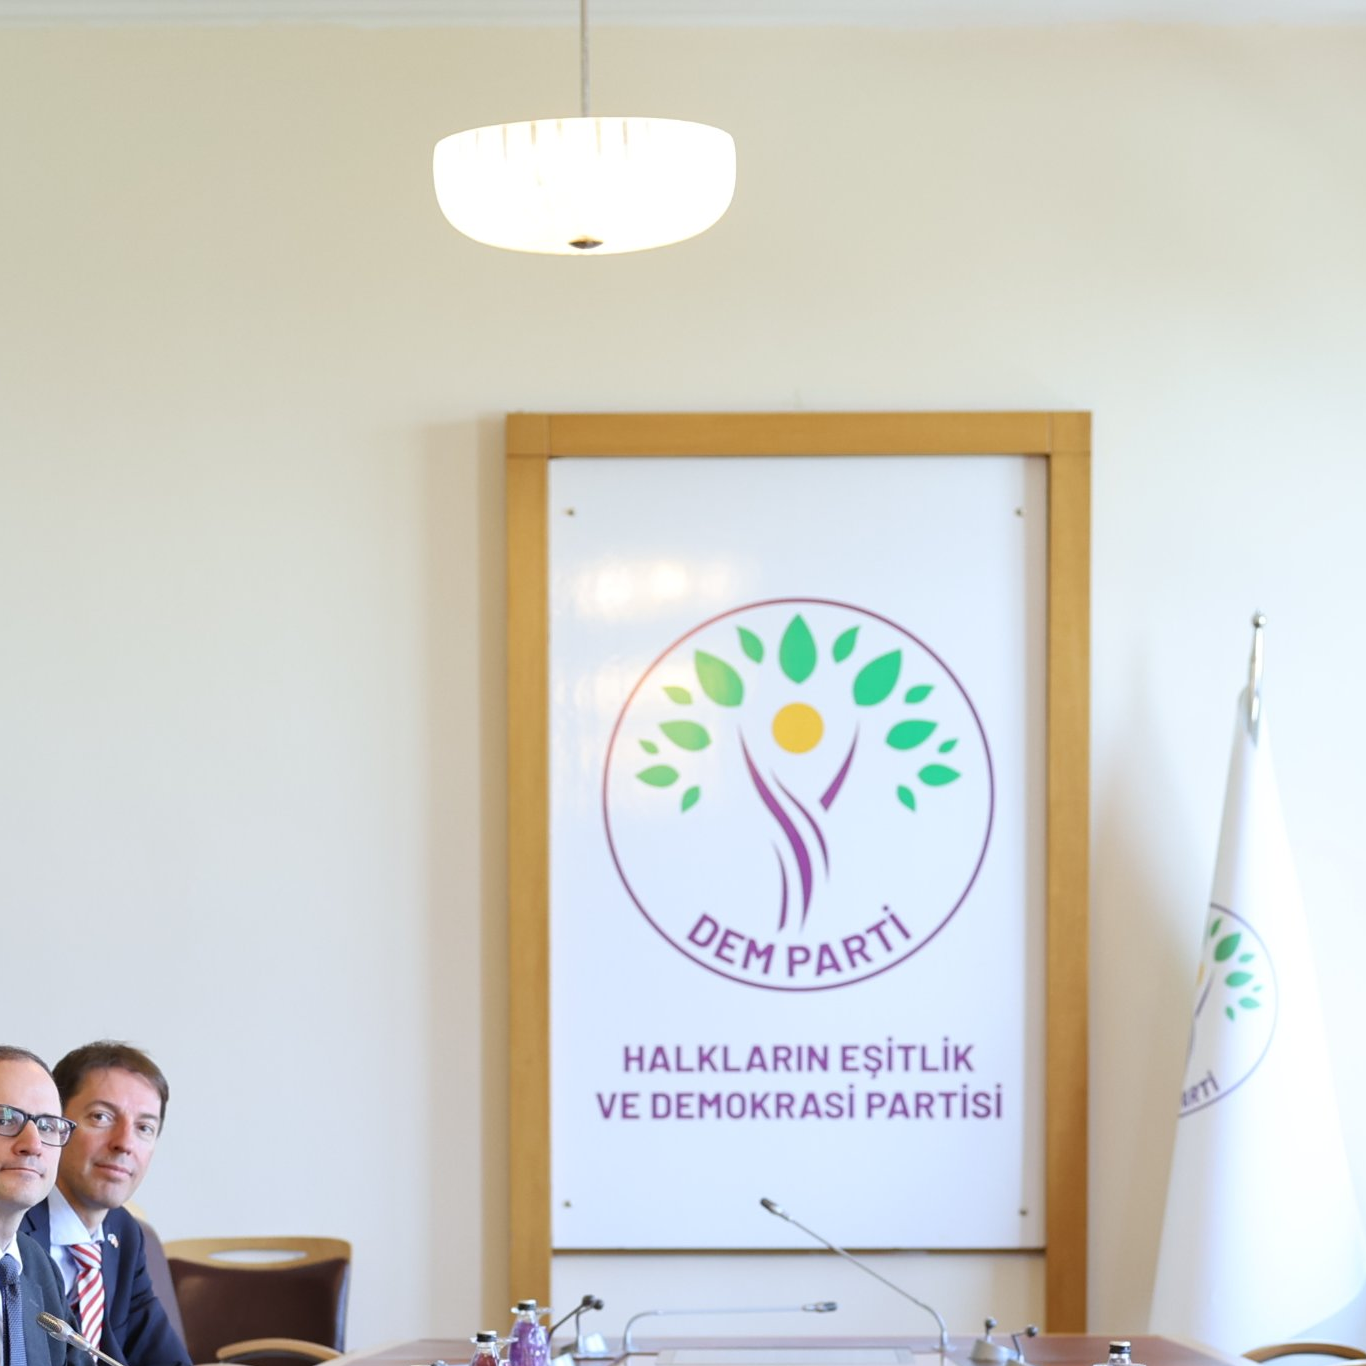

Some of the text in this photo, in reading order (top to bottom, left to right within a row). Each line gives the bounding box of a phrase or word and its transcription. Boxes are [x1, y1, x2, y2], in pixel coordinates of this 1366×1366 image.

[687, 905, 912, 978] DEM PARTİ
[623, 1036, 975, 1079] HALKLARIN EŞİTLİK
[595, 1082, 1004, 1121] VE DEMOKRASİ PARTİSİ
